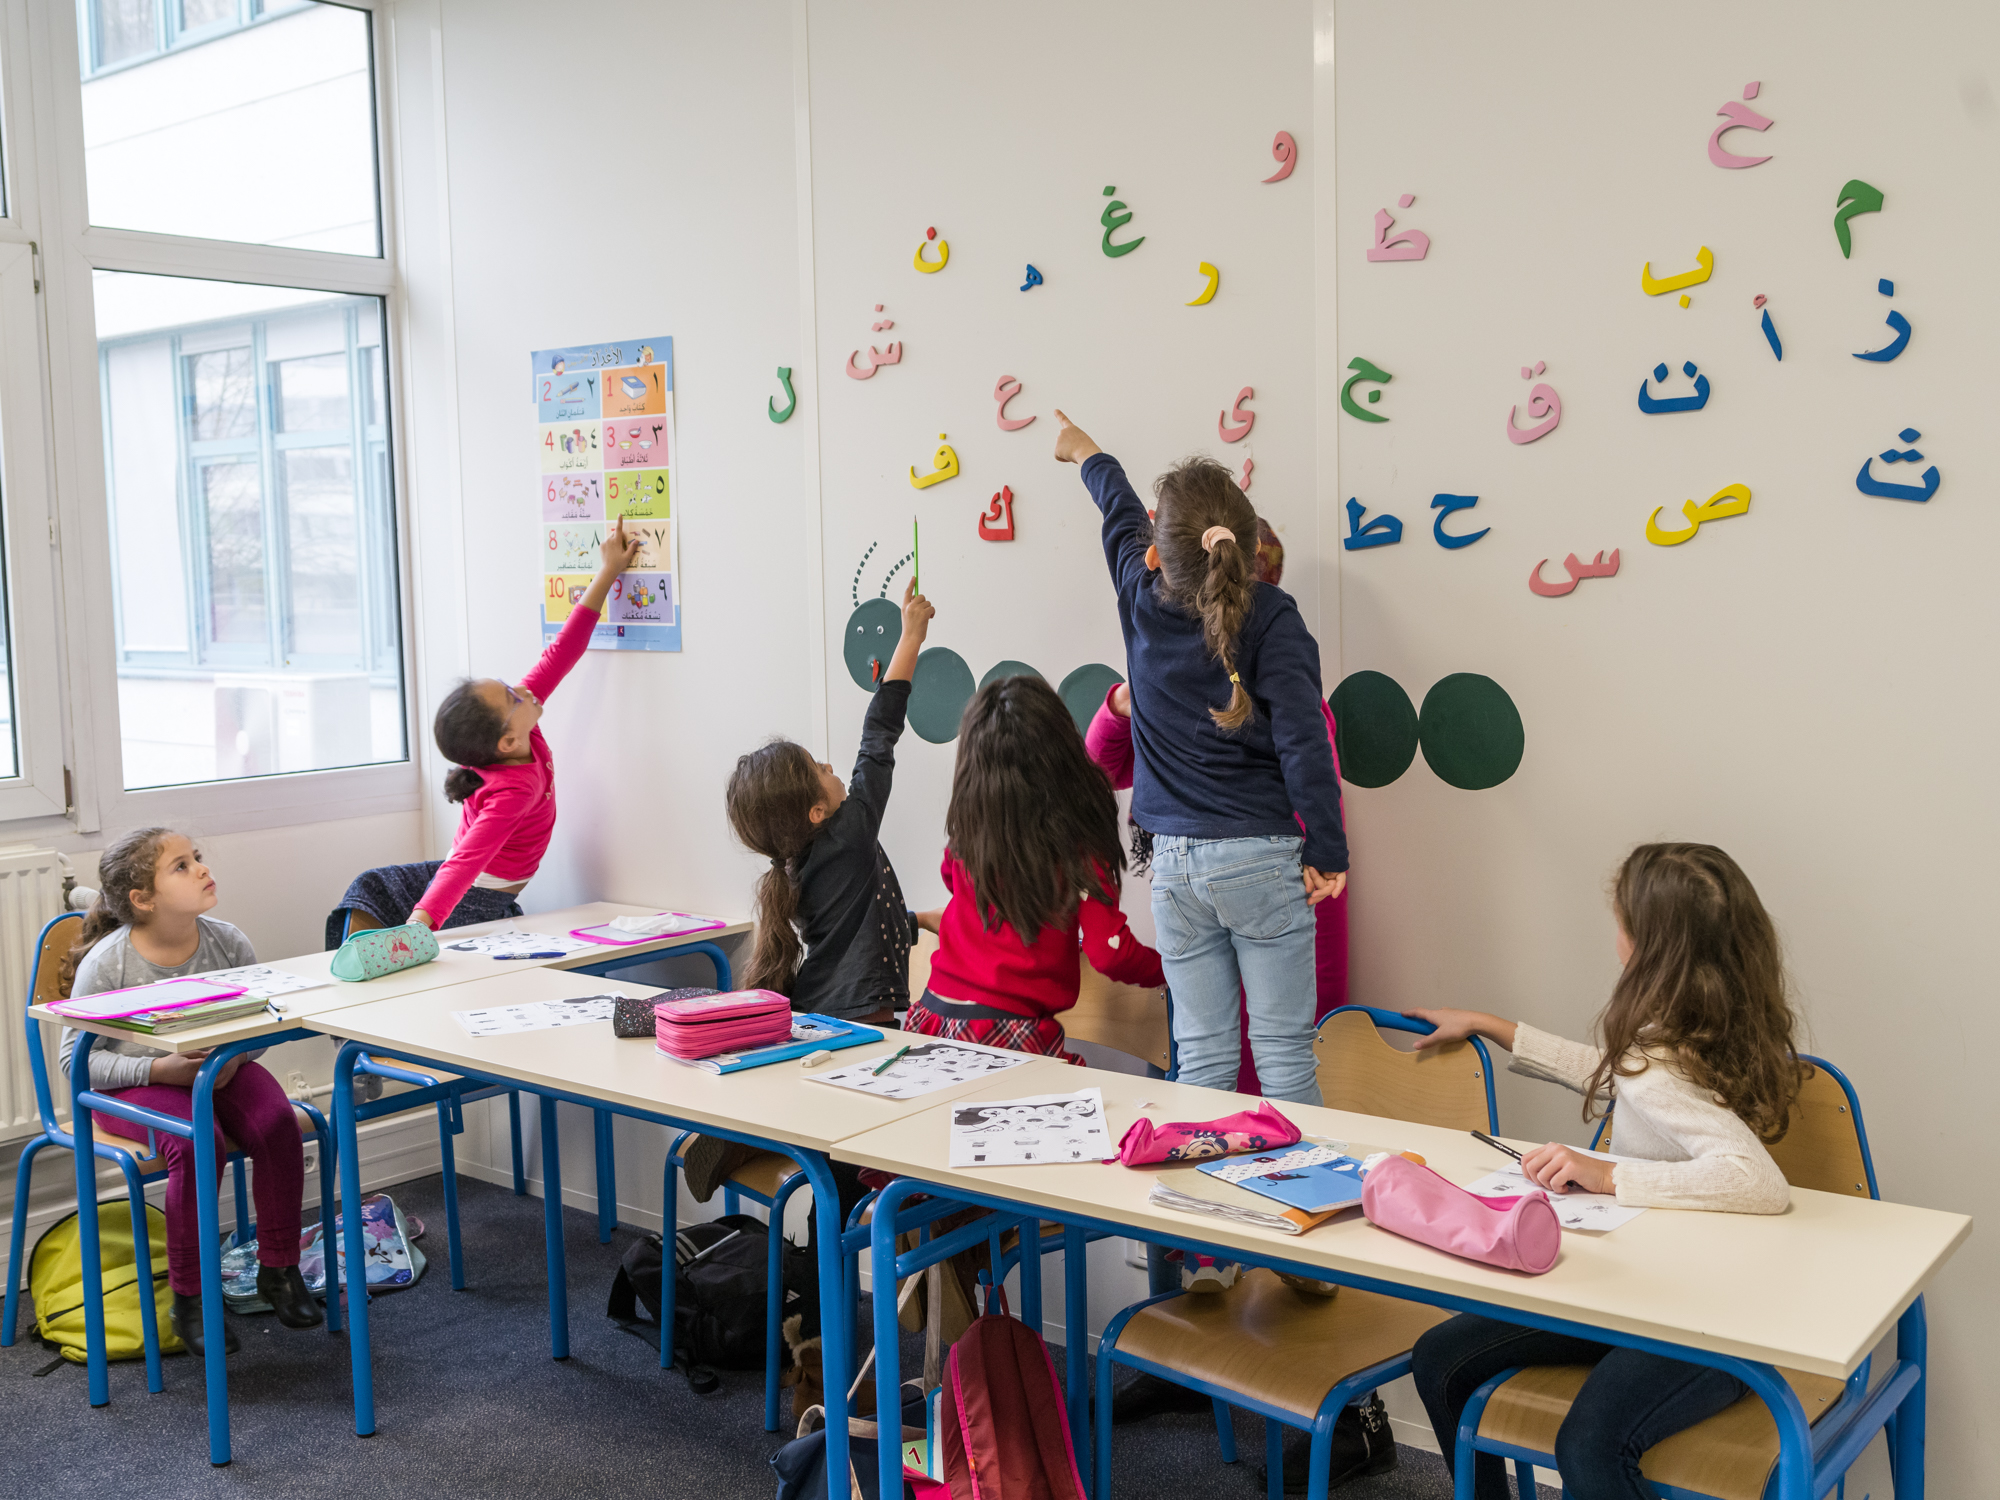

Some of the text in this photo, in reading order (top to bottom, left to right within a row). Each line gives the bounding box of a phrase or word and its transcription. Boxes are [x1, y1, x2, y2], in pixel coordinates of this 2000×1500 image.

[1708, 81, 1773, 168] خ
[1261, 130, 1298, 183] و
[1100, 185, 1146, 258] غ
[1367, 194, 1430, 262] ظ
[1833, 179, 1885, 260] م
[912, 226, 951, 274] ن
[1641, 245, 1715, 309] ب
[1184, 261, 1221, 307] ر
[845, 303, 904, 380] ش
[1852, 278, 1912, 362] ز
[543, 381, 552, 402] 2
[606, 375, 613, 397] 1
[994, 375, 1037, 431] ع
[1340, 356, 1393, 423] ج
[1506, 360, 1562, 444] ق
[1637, 360, 1711, 415] ت
[544, 430, 554, 451] 4
[606, 426, 616, 448] 3
[909, 432, 961, 490] ف
[547, 480, 556, 502] 6
[609, 477, 619, 499] 5
[1855, 427, 1941, 503] ث
[548, 529, 558, 551] 8
[977, 484, 1017, 542] ك
[1343, 496, 1403, 551] ط
[1430, 493, 1491, 550] ح
[1644, 482, 1753, 548] ص
[548, 577, 565, 598] 10
[612, 578, 623, 601] 9
[1528, 547, 1621, 599] س
